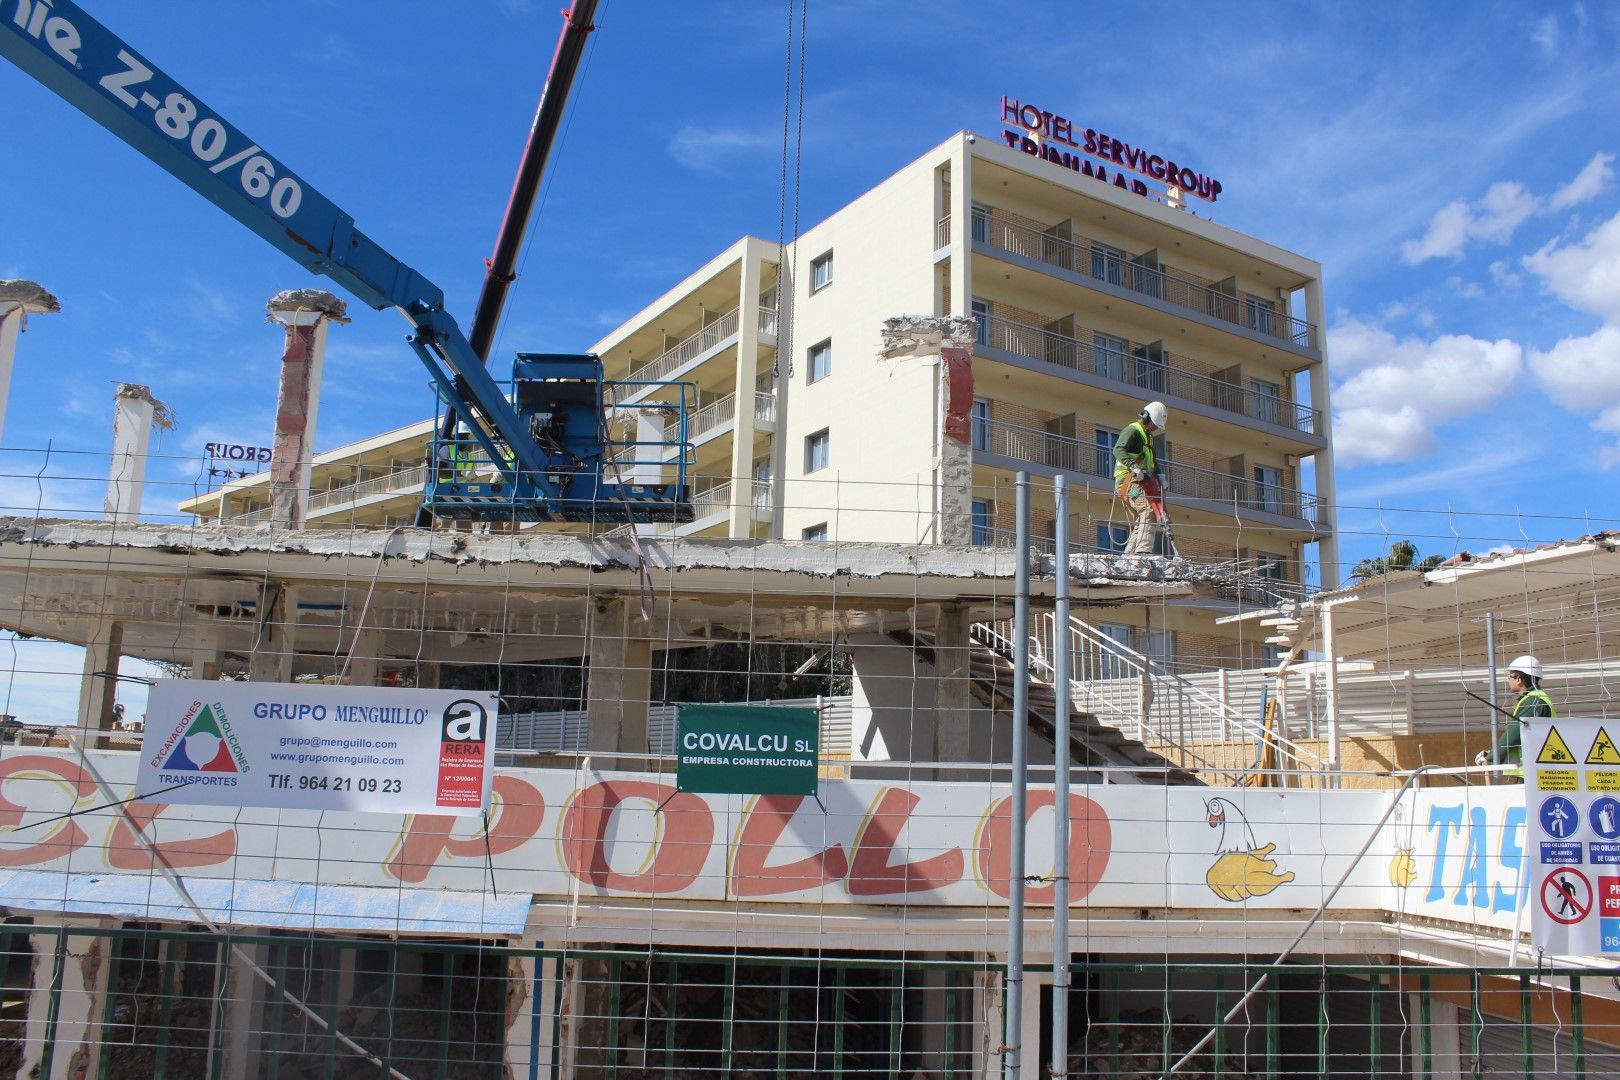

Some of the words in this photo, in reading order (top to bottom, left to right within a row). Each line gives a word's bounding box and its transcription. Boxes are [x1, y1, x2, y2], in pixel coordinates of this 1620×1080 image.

[99, 49, 302, 218] Z-80/60
[1000, 95, 1078, 147] HOTEL
[1083, 128, 1222, 202] SERVIGROUP
[254, 702, 327, 721] GRUPO
[151, 700, 202, 768] EXCAVACIONES
[213, 702, 250, 774] DEMOLICIONES
[279, 736, 397, 749] grupo@menguillo.com
[683, 732, 788, 752] COVALCU
[794, 739, 814, 753] SL
[445, 743, 481, 755] RERA
[270, 752, 404, 766] www.grupomenguillo.com
[683, 756, 730, 765] EMPRESA
[732, 757, 813, 767] CONSTRUCTORA
[159, 774, 238, 787] TRANSPORTES
[268, 774, 293, 789] Tlf.
[299, 775, 328, 790] 964
[333, 776, 351, 791] 21
[358, 778, 377, 792] 09
[382, 779, 402, 793] 23
